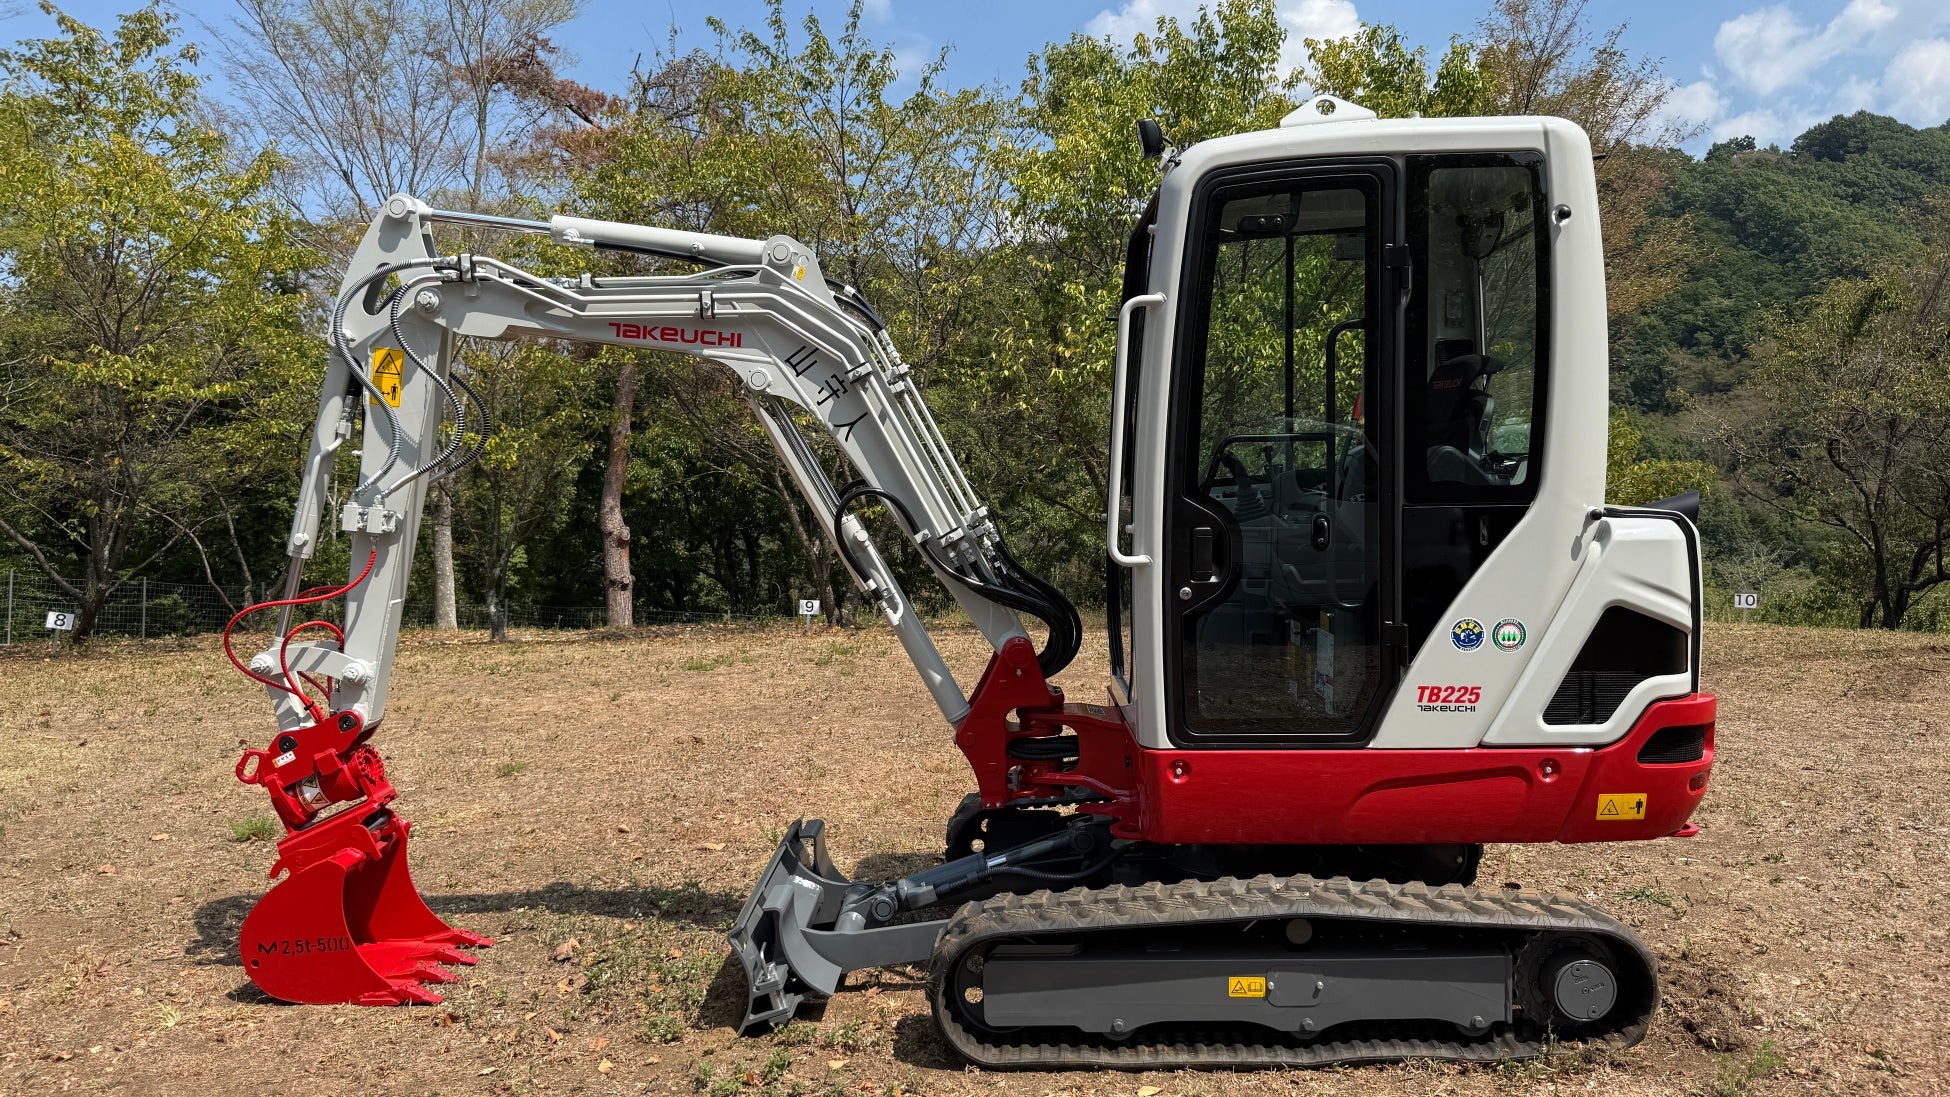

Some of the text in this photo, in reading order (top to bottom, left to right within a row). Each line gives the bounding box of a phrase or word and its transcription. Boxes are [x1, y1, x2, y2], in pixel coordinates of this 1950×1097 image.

[784, 345, 869, 443] 山守人
[805, 600, 814, 613] 9
[1736, 594, 1756, 606] 10
[54, 613, 67, 627] 8
[1417, 685, 1482, 704] TB225
